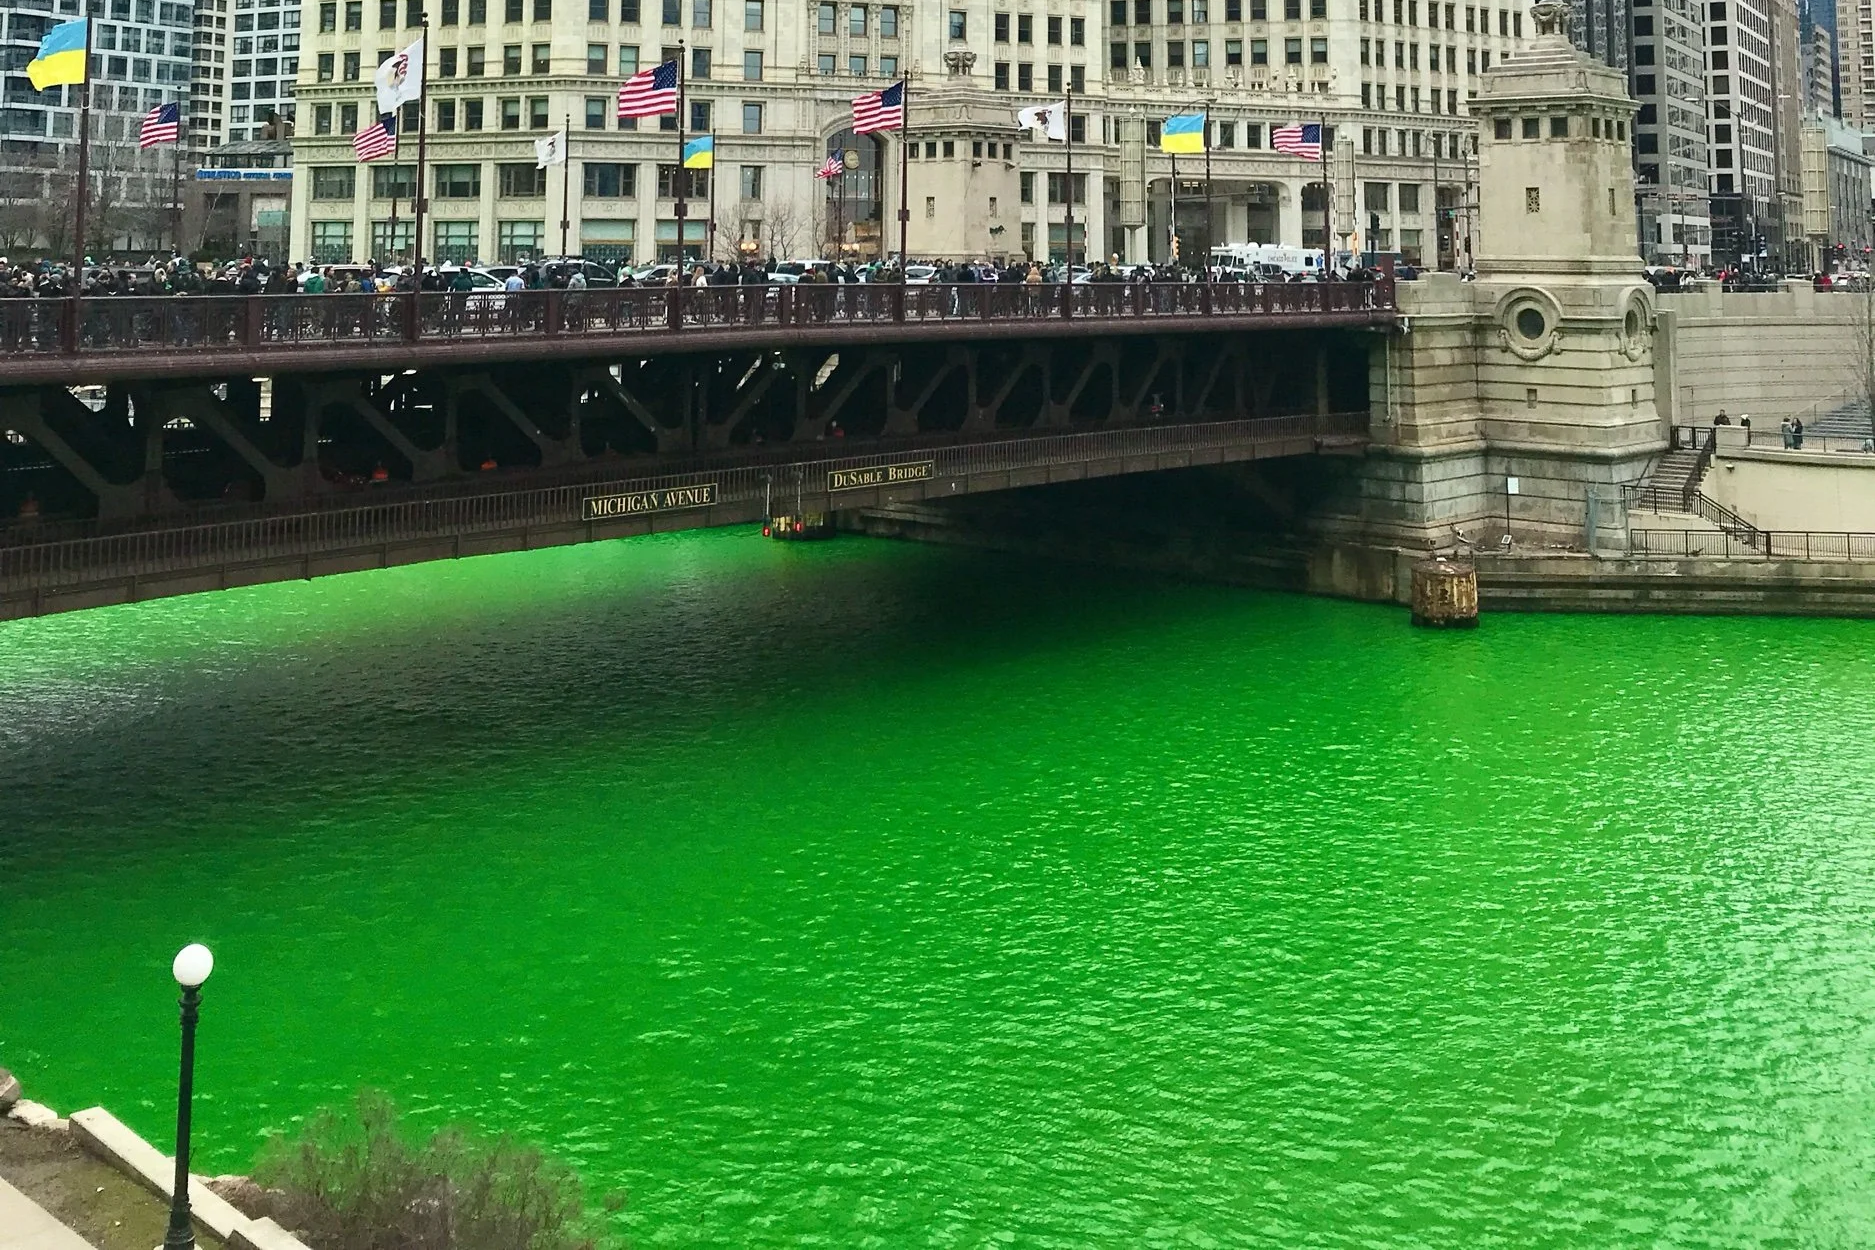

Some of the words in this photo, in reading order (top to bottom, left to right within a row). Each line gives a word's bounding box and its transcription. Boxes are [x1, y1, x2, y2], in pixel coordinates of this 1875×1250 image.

[888, 466, 928, 481] BRIDGE
[590, 492, 658, 517] MICHIGAN
[663, 487, 711, 508] AVENUE
